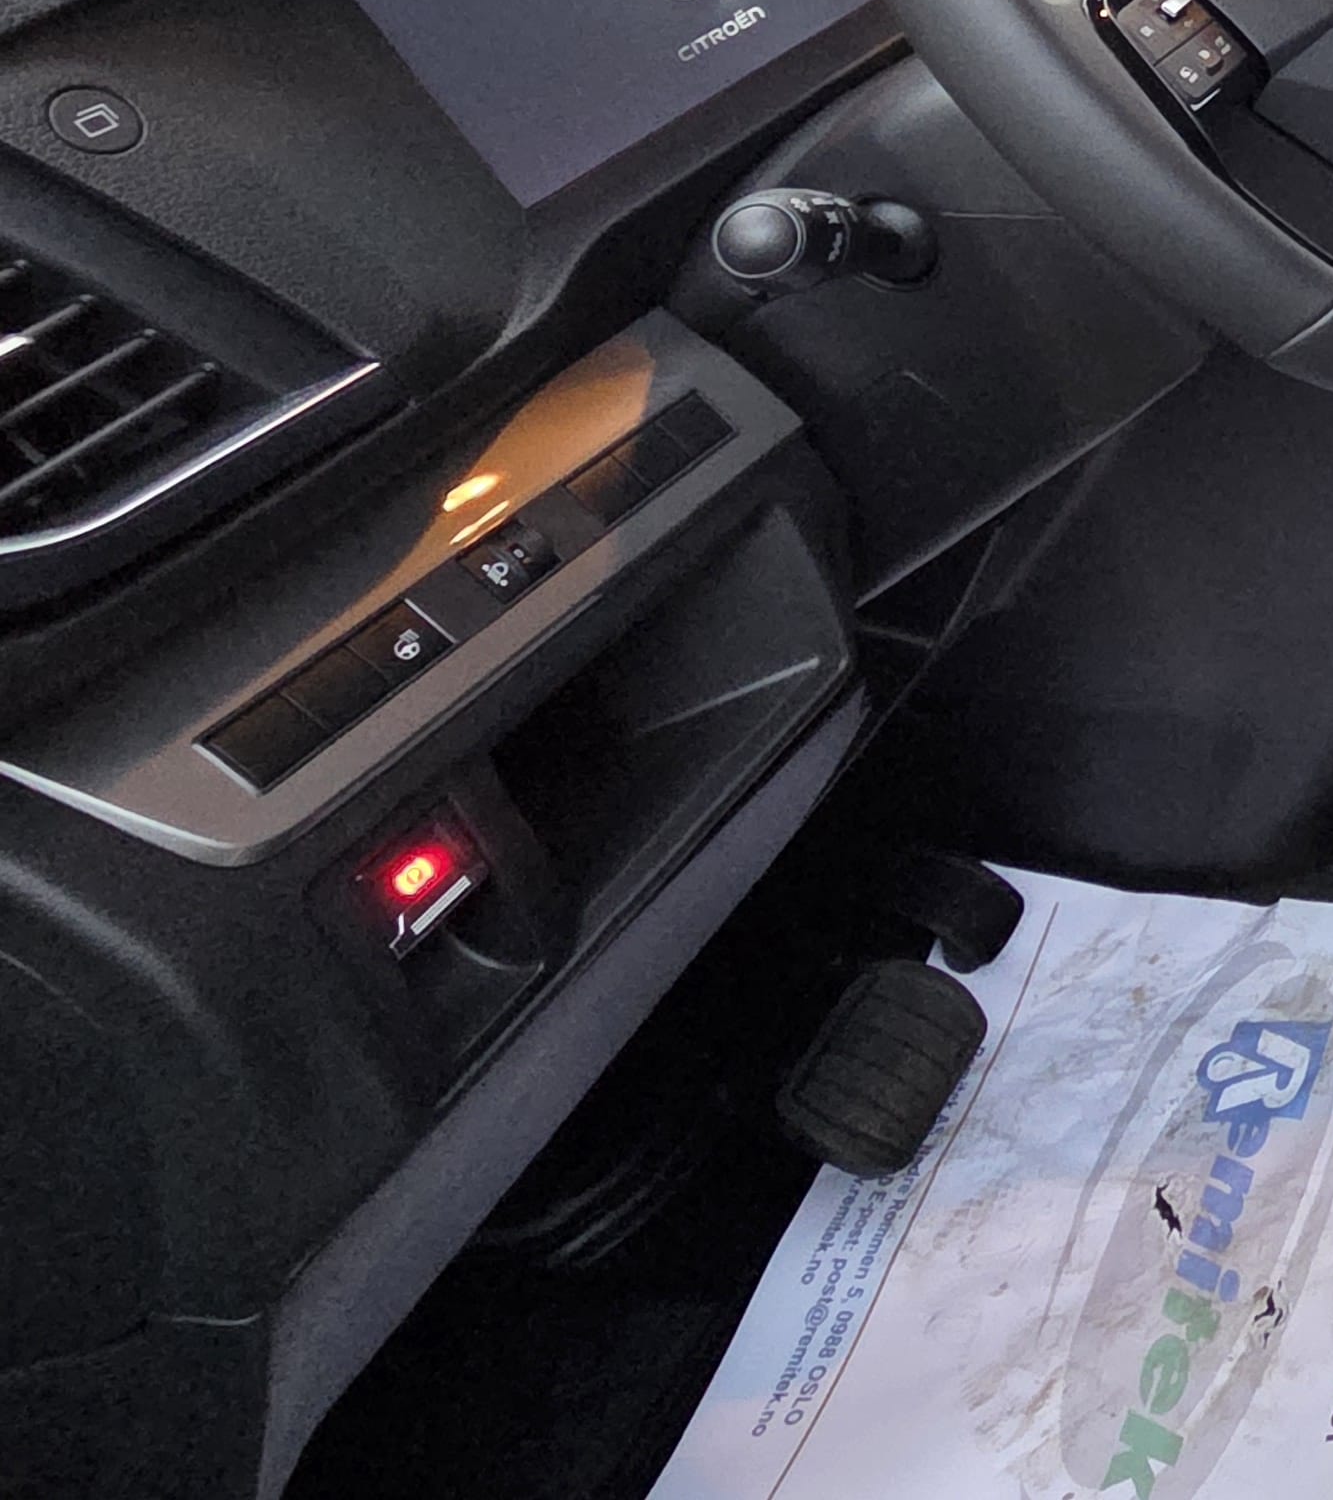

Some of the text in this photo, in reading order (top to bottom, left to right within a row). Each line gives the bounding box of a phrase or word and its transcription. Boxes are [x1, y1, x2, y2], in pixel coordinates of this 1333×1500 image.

[854, 1198, 907, 1279] Rommen
[1100, 1028, 1311, 1500] Remitek
[751, 1190, 887, 1437] E-post: post@remitek.no
[840, 1286, 864, 1303] 5,
[818, 1310, 855, 1359] 0988
[784, 1365, 827, 1426] OSLO
